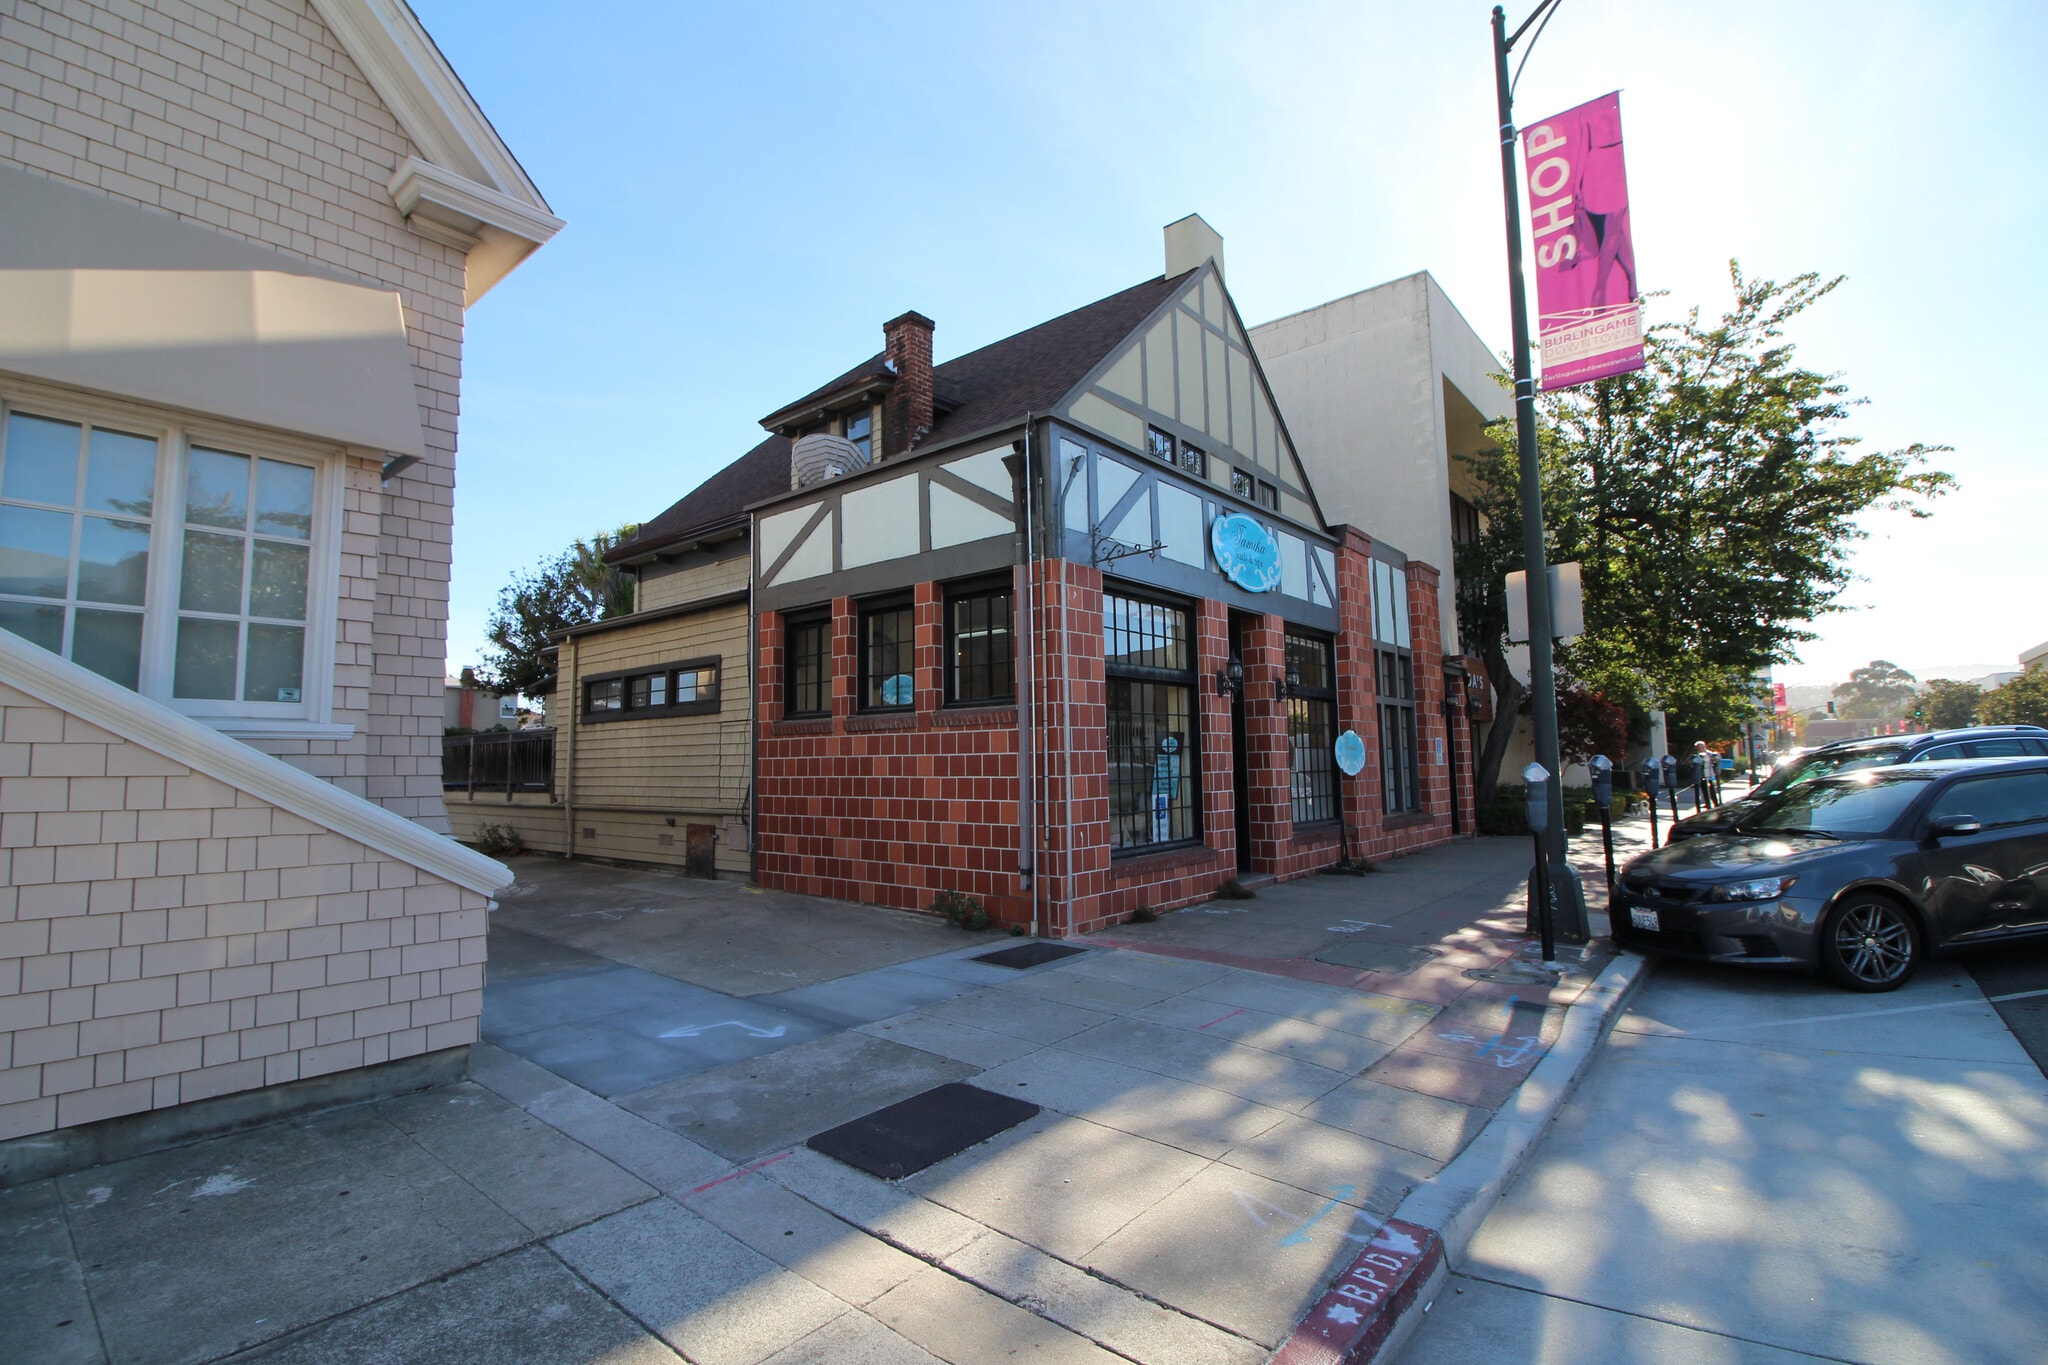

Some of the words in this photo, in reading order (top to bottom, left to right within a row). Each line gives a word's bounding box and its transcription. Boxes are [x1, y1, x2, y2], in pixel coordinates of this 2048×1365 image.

[1527, 124, 1578, 269] SHOP
[1544, 327, 1638, 359] DOWNTOWN
[1545, 315, 1637, 348] BURLINGAME
